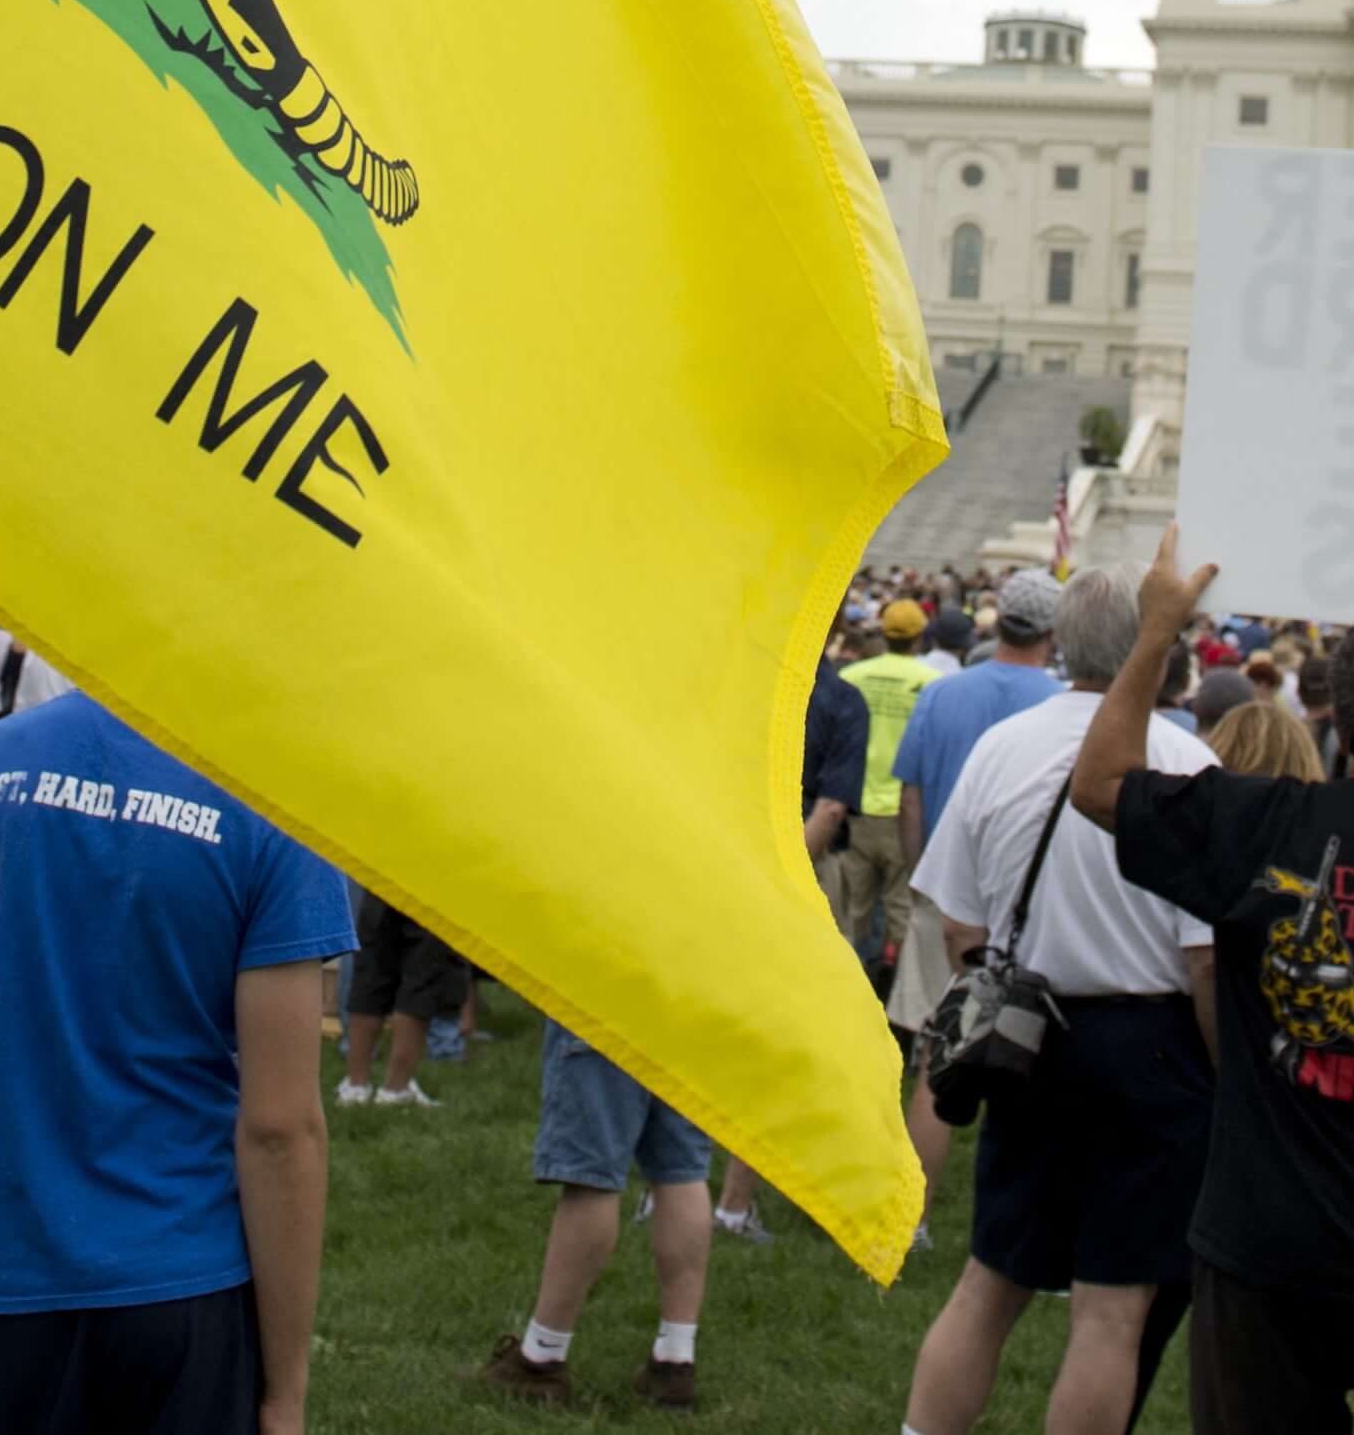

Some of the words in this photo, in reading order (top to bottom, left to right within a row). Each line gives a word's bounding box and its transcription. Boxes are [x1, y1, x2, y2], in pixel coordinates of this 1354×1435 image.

[155, 297, 390, 548] ME
[33, 772, 117, 822] HARD,
[121, 788, 222, 844] FINISH.
